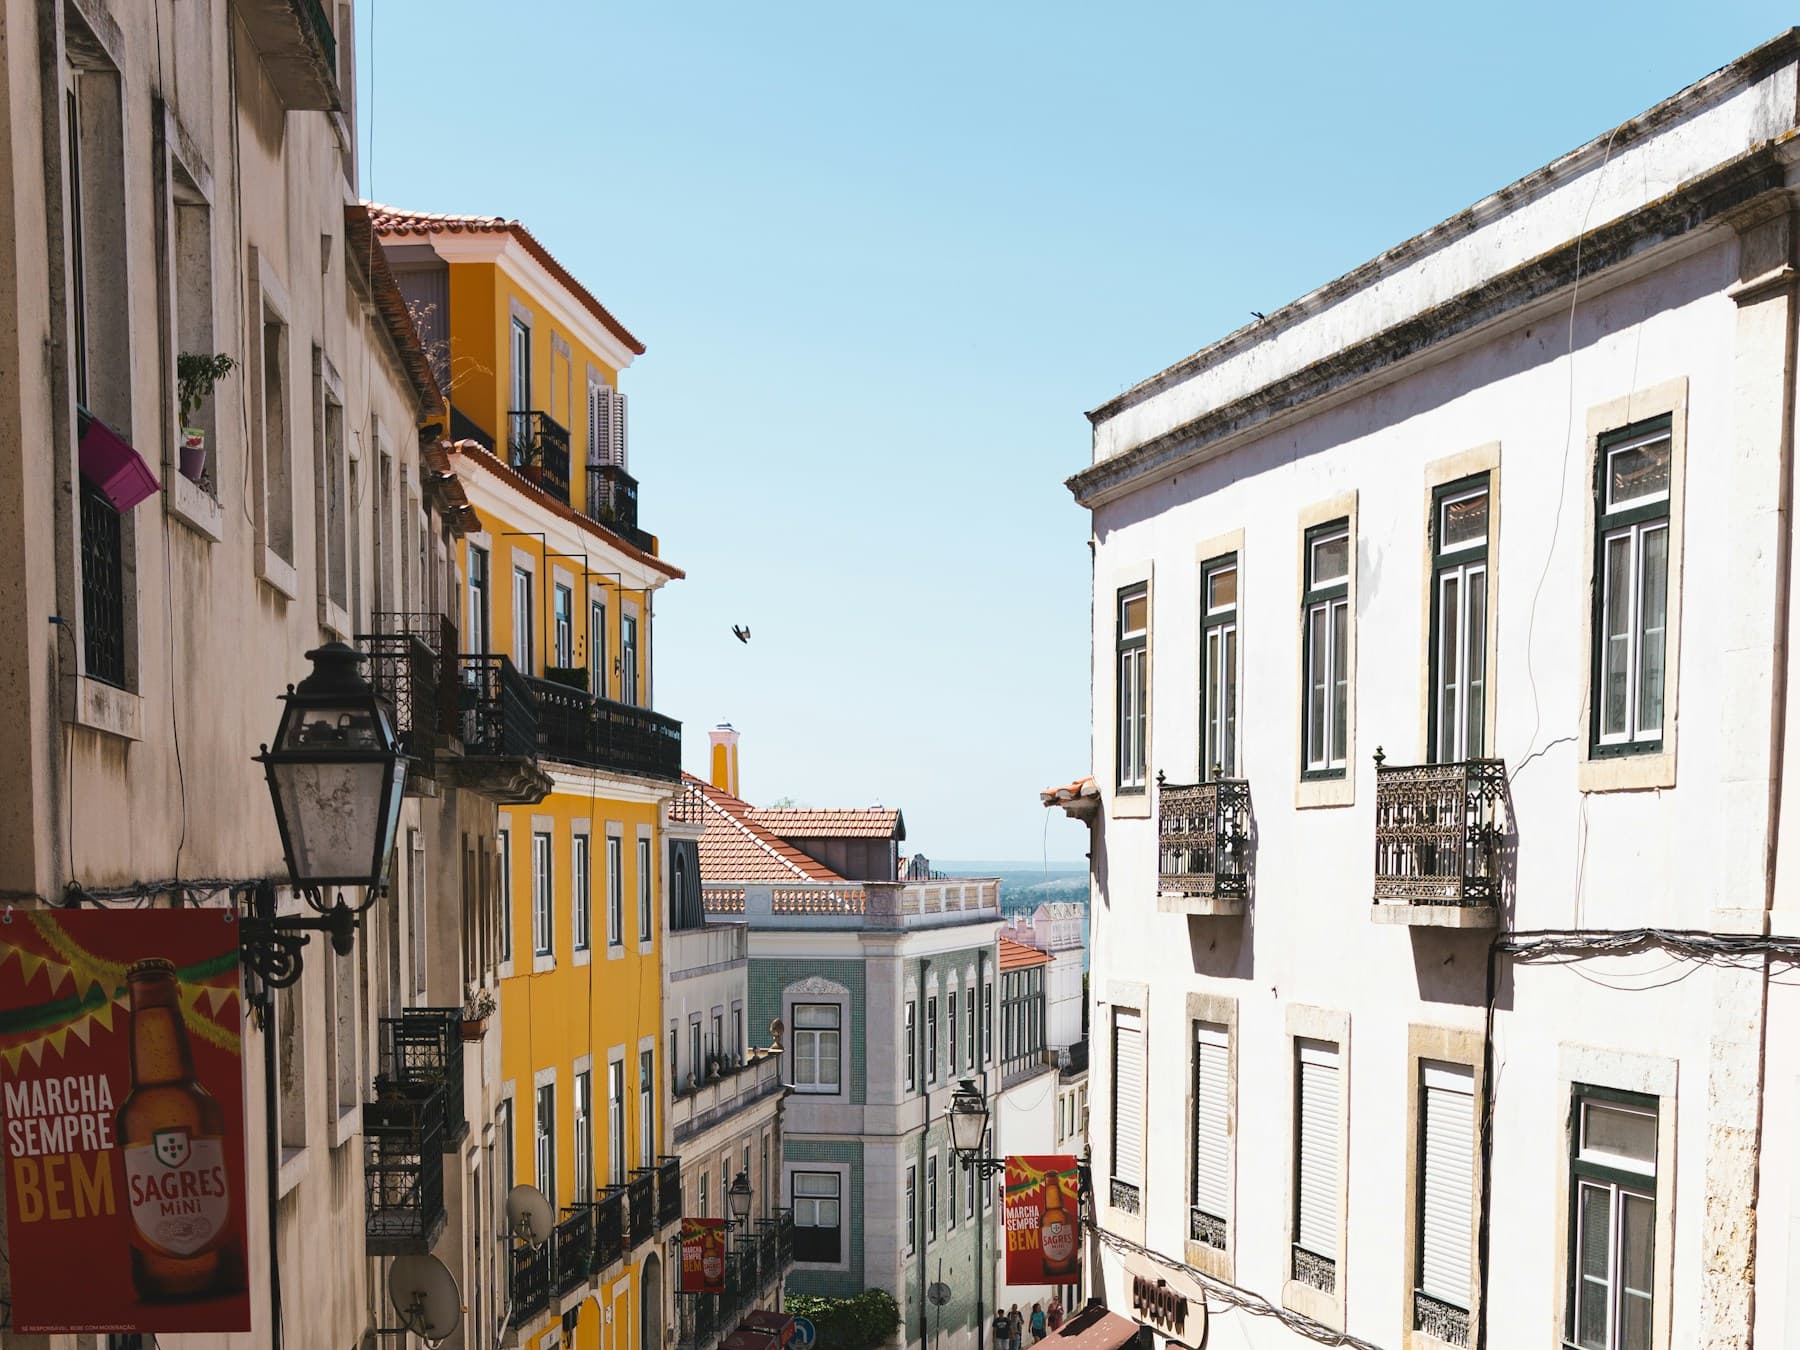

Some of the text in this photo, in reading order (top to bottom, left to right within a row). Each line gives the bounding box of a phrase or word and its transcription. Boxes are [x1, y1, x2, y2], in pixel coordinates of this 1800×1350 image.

[4, 1074, 114, 1118] MARCHA
[8, 1112, 114, 1157] SEMPRE
[13, 1150, 116, 1223] BEM
[131, 1166, 225, 1207] SAGRES
[1006, 1205, 1040, 1219] MARCHA
[1007, 1217, 1040, 1231] SEMPRE
[1008, 1229, 1040, 1251] BEM
[1043, 1234, 1072, 1247] SAGRES
[683, 1260, 702, 1272] BEM
